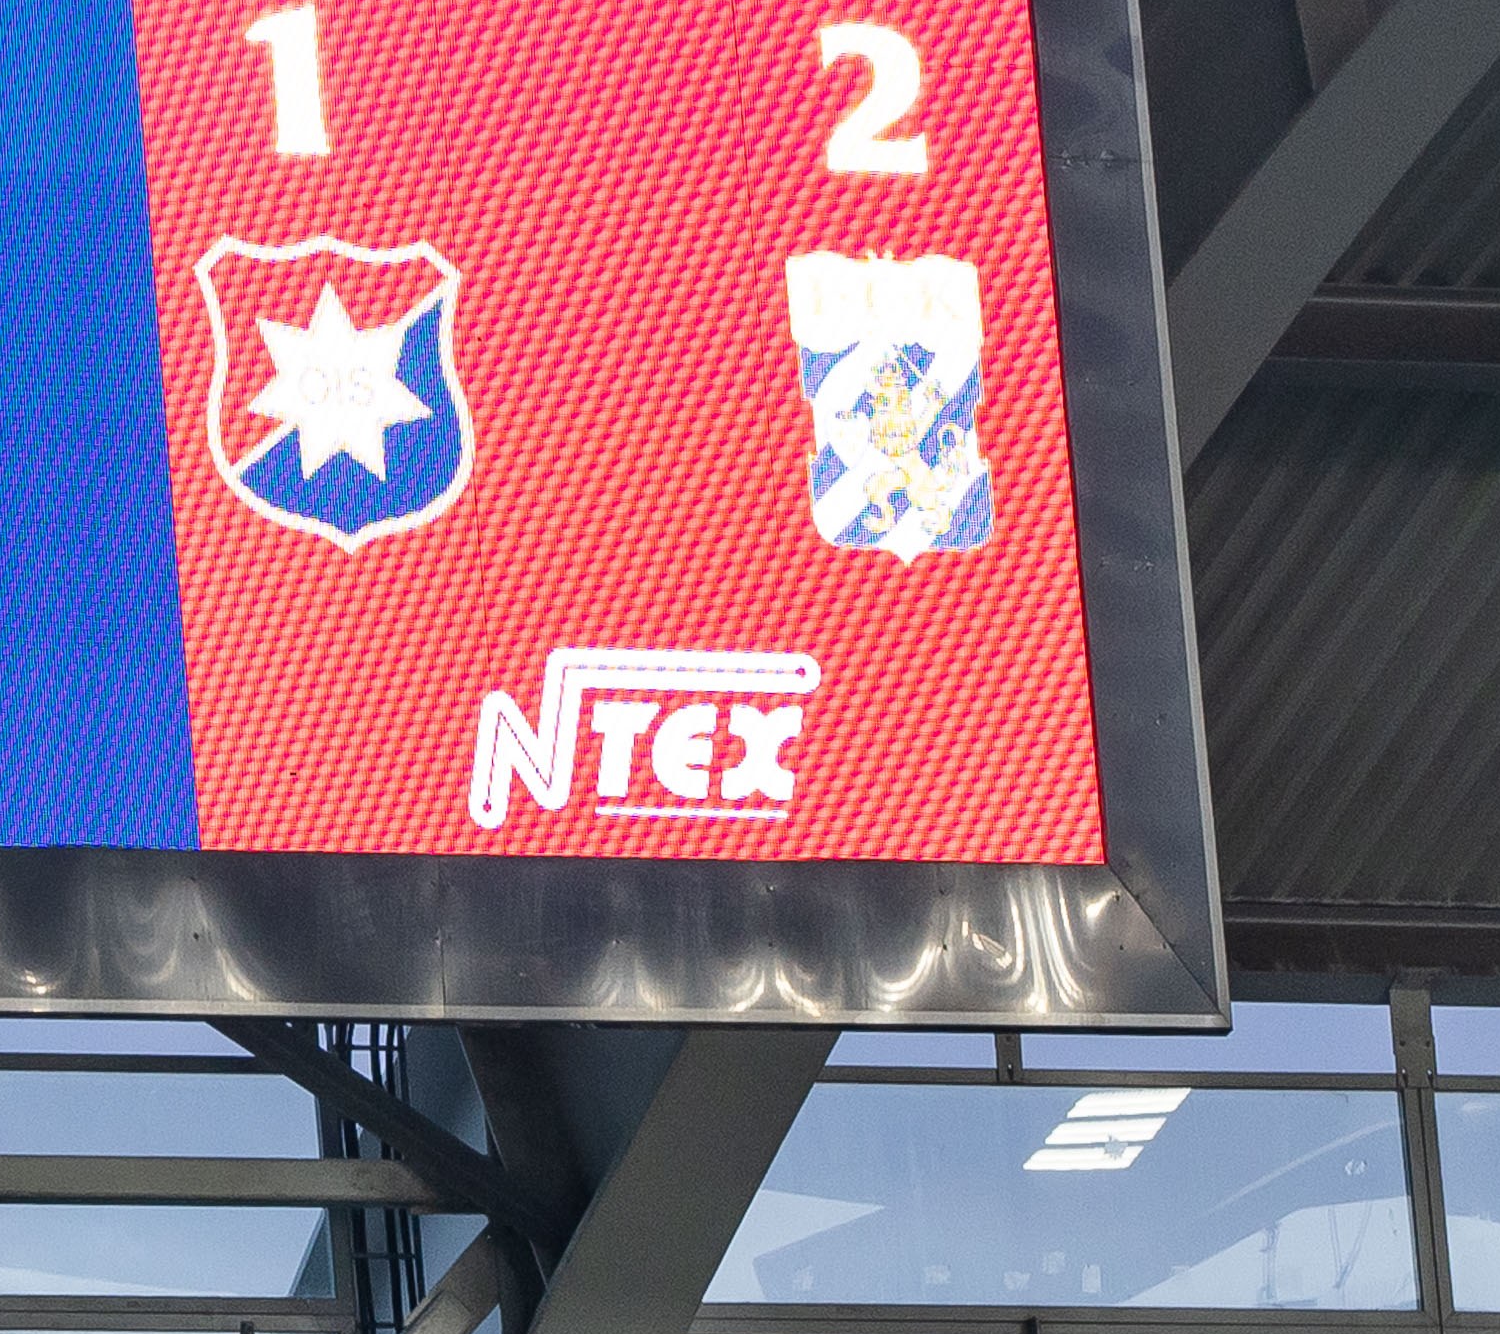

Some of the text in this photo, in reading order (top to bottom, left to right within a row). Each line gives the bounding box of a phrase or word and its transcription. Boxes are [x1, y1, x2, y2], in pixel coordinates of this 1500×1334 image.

[244, 2, 331, 158] 1
[819, 21, 929, 176] 2
[468, 646, 822, 829] NTEX
